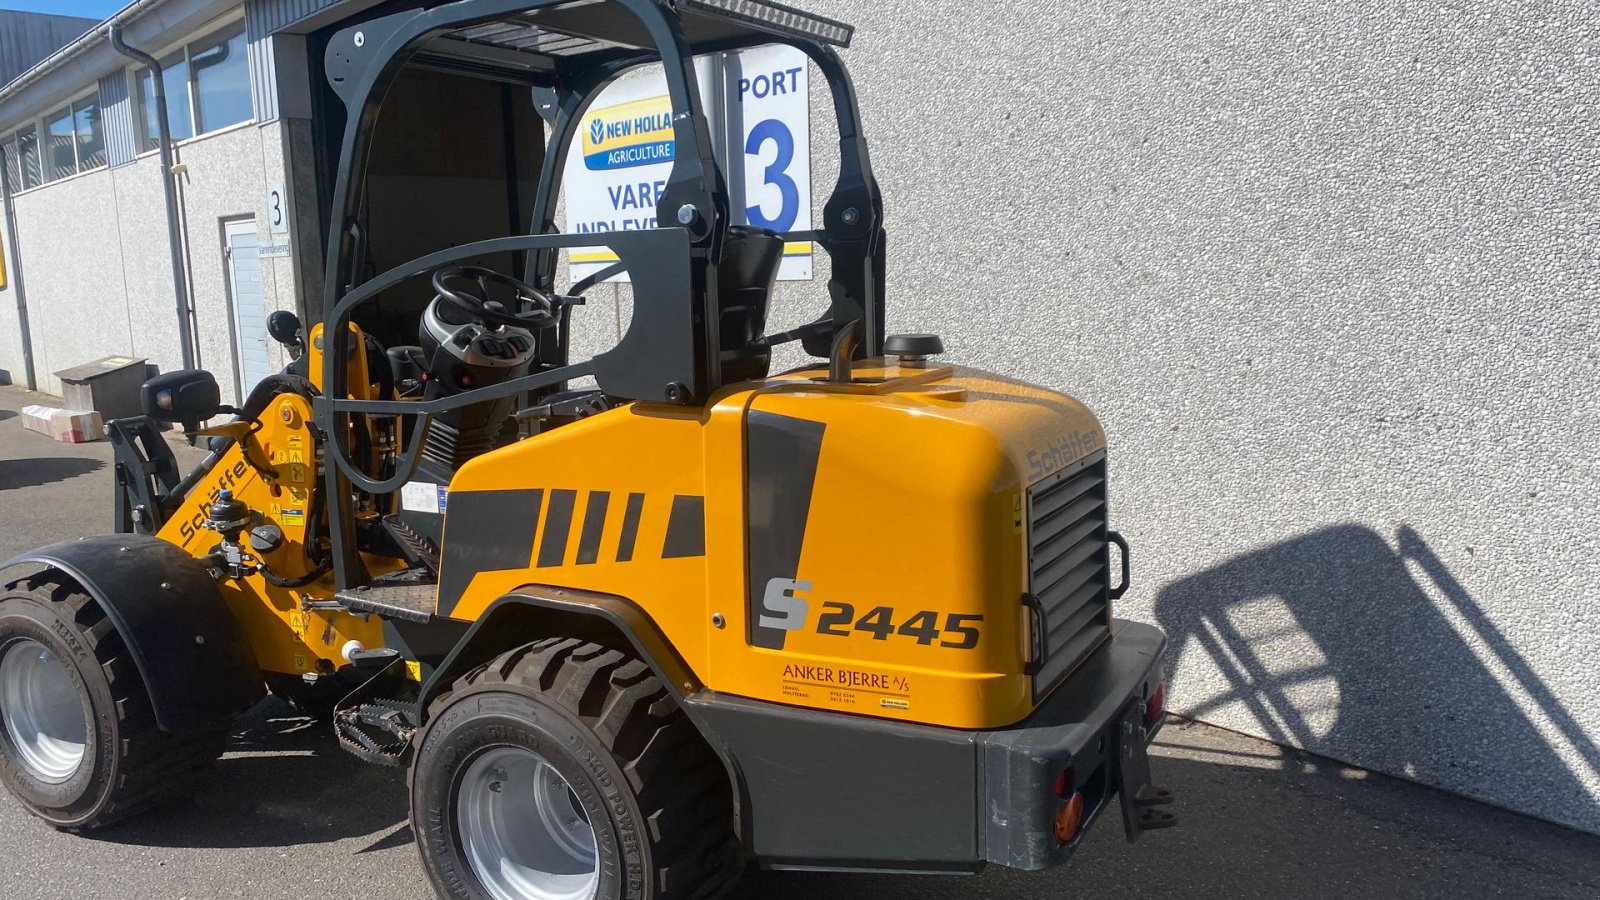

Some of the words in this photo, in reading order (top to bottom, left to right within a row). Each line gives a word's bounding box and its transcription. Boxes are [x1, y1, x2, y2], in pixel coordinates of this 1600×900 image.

[737, 66, 802, 102] PORT
[606, 119, 632, 139] NEW
[634, 112, 674, 134] HOLLA
[608, 143, 671, 165] AGRICULTURE
[744, 118, 800, 233] 3
[271, 190, 282, 226] 3
[1026, 429, 1098, 481] Schäffer
[758, 576, 813, 631] S
[815, 600, 984, 650] 2445
[782, 664, 834, 683] ANKER
[838, 669, 890, 689] BJERRE
[892, 676, 910, 692] A/S
